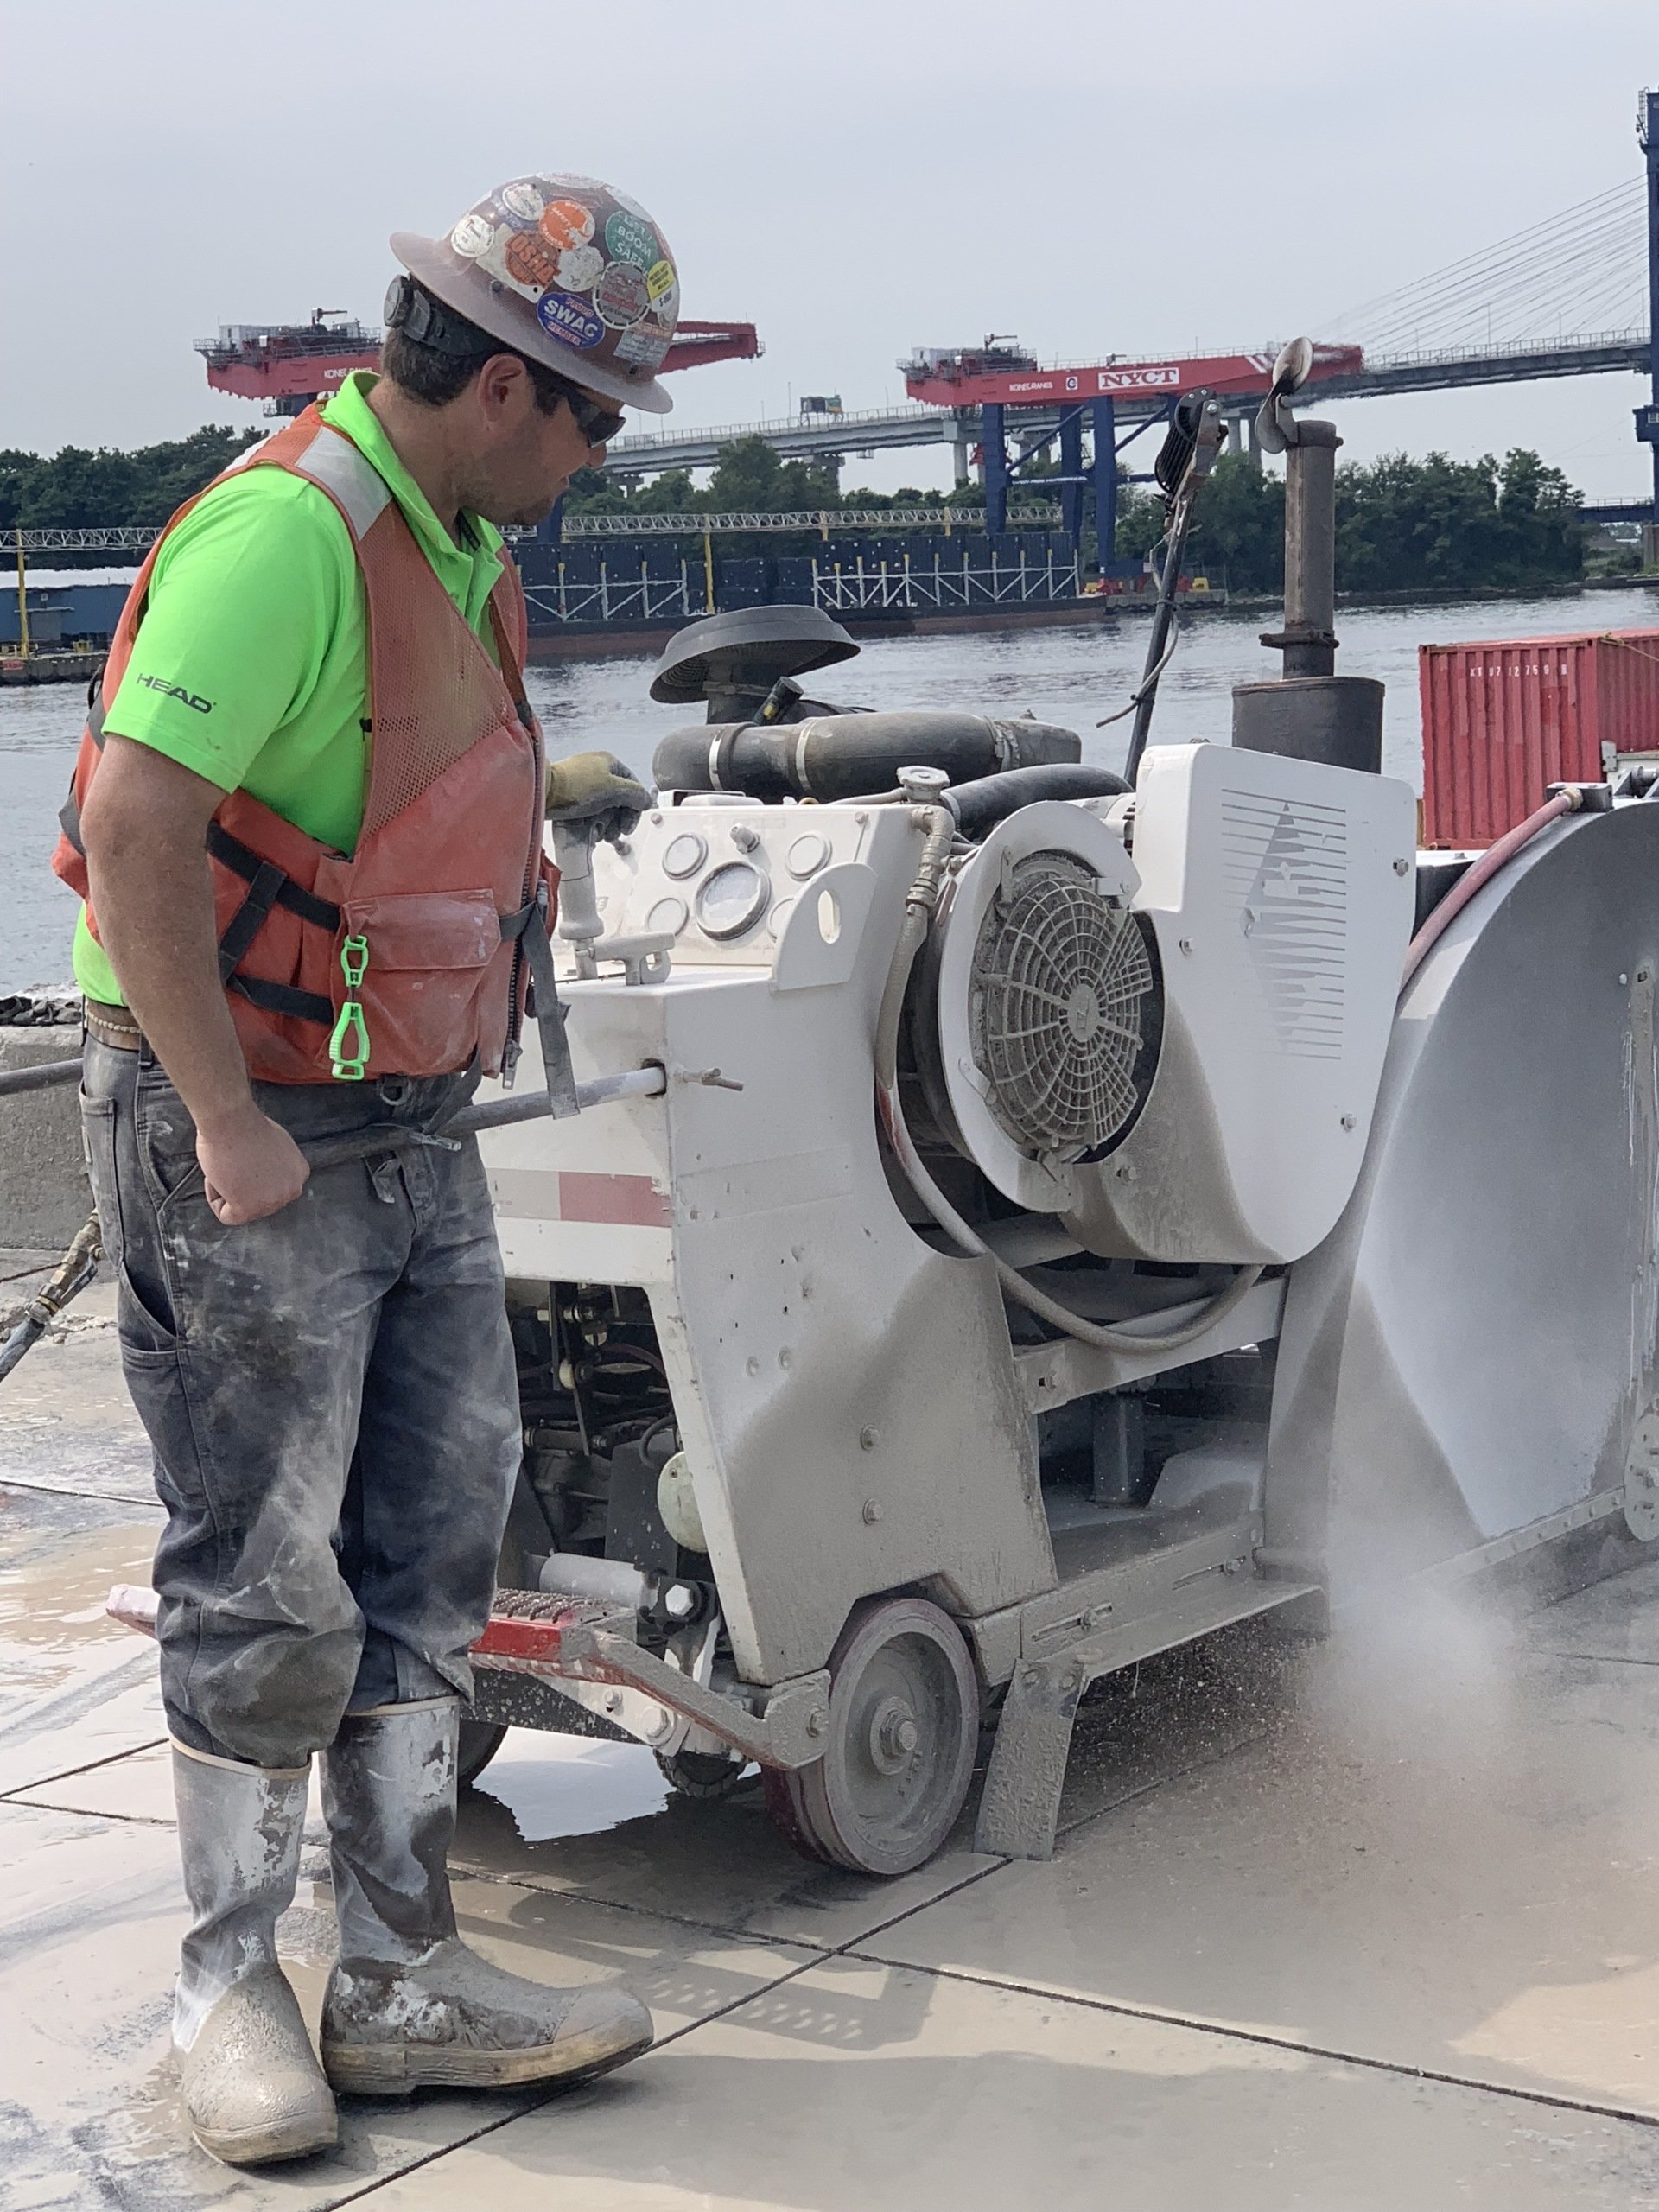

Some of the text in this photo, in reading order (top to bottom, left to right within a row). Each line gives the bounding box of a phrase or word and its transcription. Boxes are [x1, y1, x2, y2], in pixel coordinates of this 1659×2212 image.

[617, 225, 652, 258] BOOM
[511, 233, 556, 286] OSHA
[544, 299, 598, 338] SWAC
[565, 296, 594, 318] PROUD
[547, 321, 582, 346] MEMBER
[1102, 369, 1177, 388] NYCT
[137, 673, 212, 715] HEAD
